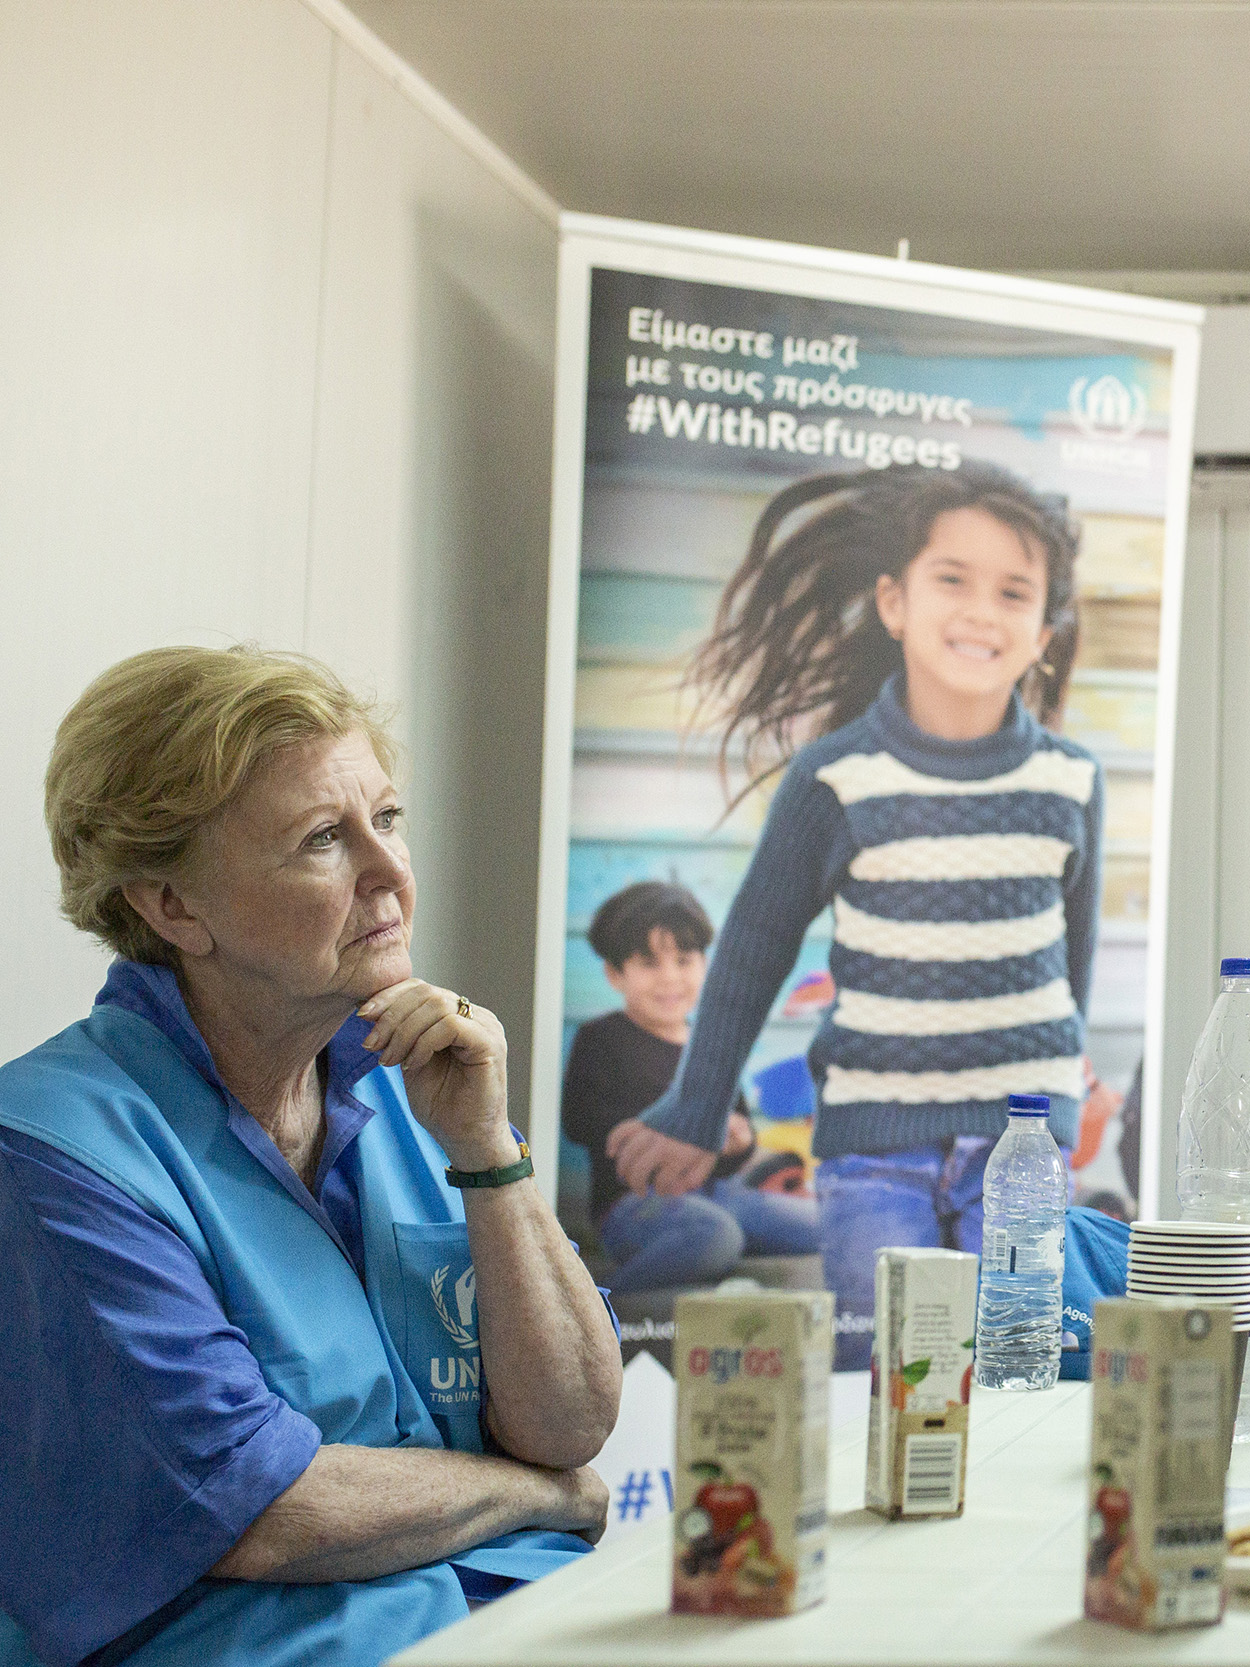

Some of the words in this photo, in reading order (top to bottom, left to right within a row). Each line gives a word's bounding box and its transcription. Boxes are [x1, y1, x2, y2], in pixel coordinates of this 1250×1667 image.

[628, 306, 774, 359] Είμαστε
[782, 334, 859, 373] μαζί
[626, 355, 671, 388] με
[678, 361, 766, 404] τους
[772, 373, 973, 428] πρόσφυγες
[626, 393, 961, 471] #WithRefugees
[429, 1392, 453, 1403] The
[454, 1391, 469, 1402] UN
[430, 1356, 480, 1390] UN
